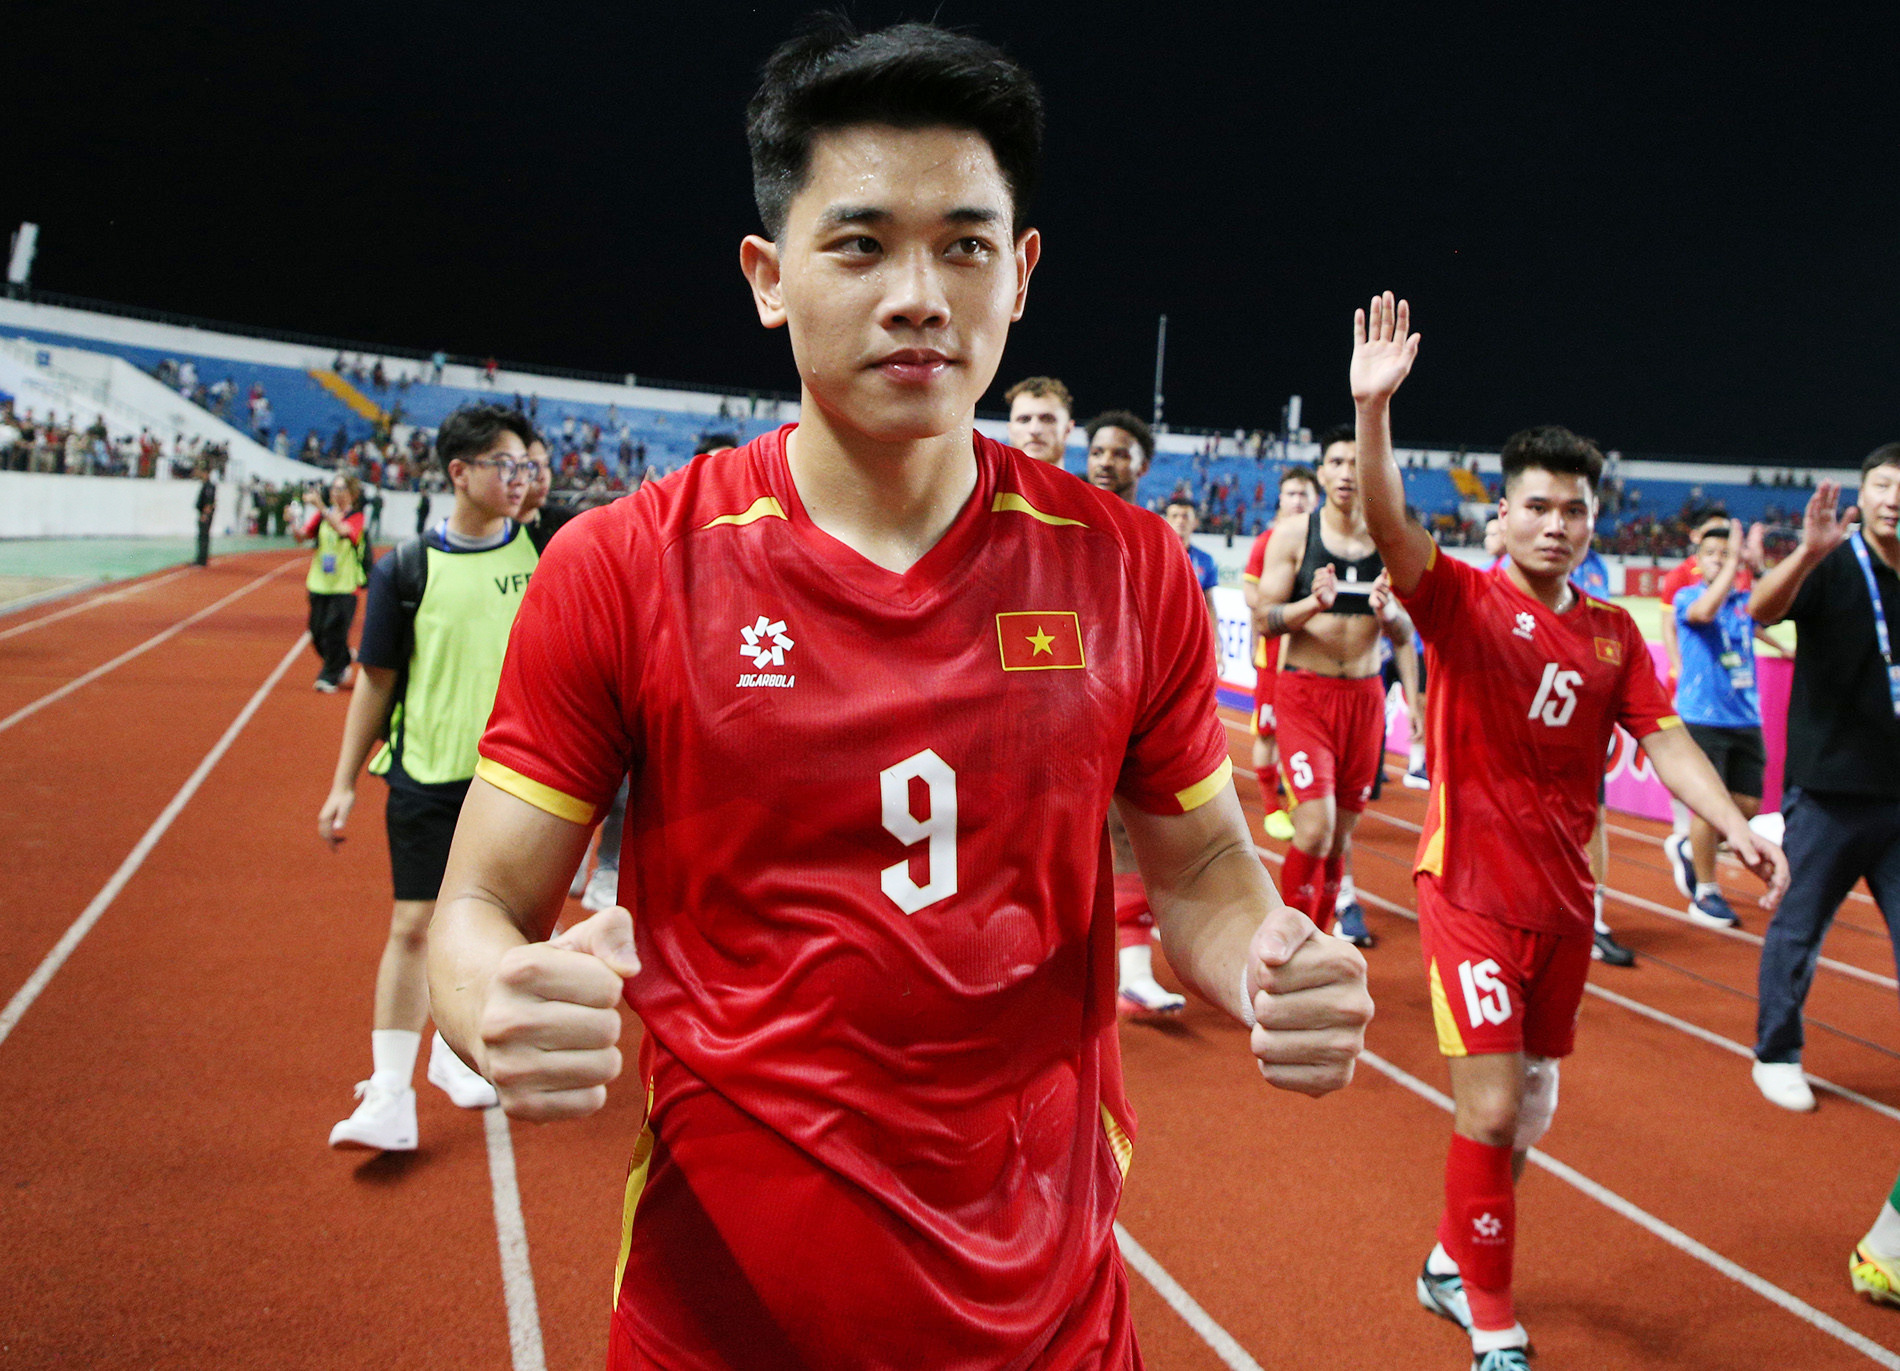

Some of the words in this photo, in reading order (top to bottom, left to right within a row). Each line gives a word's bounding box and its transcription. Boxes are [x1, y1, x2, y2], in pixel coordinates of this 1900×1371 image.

[736, 673, 795, 688] JOGARBOLA
[1528, 662, 1584, 727] 15
[1290, 750, 1314, 789] 5
[880, 748, 958, 915] 9
[1458, 958, 1512, 1029] 15
